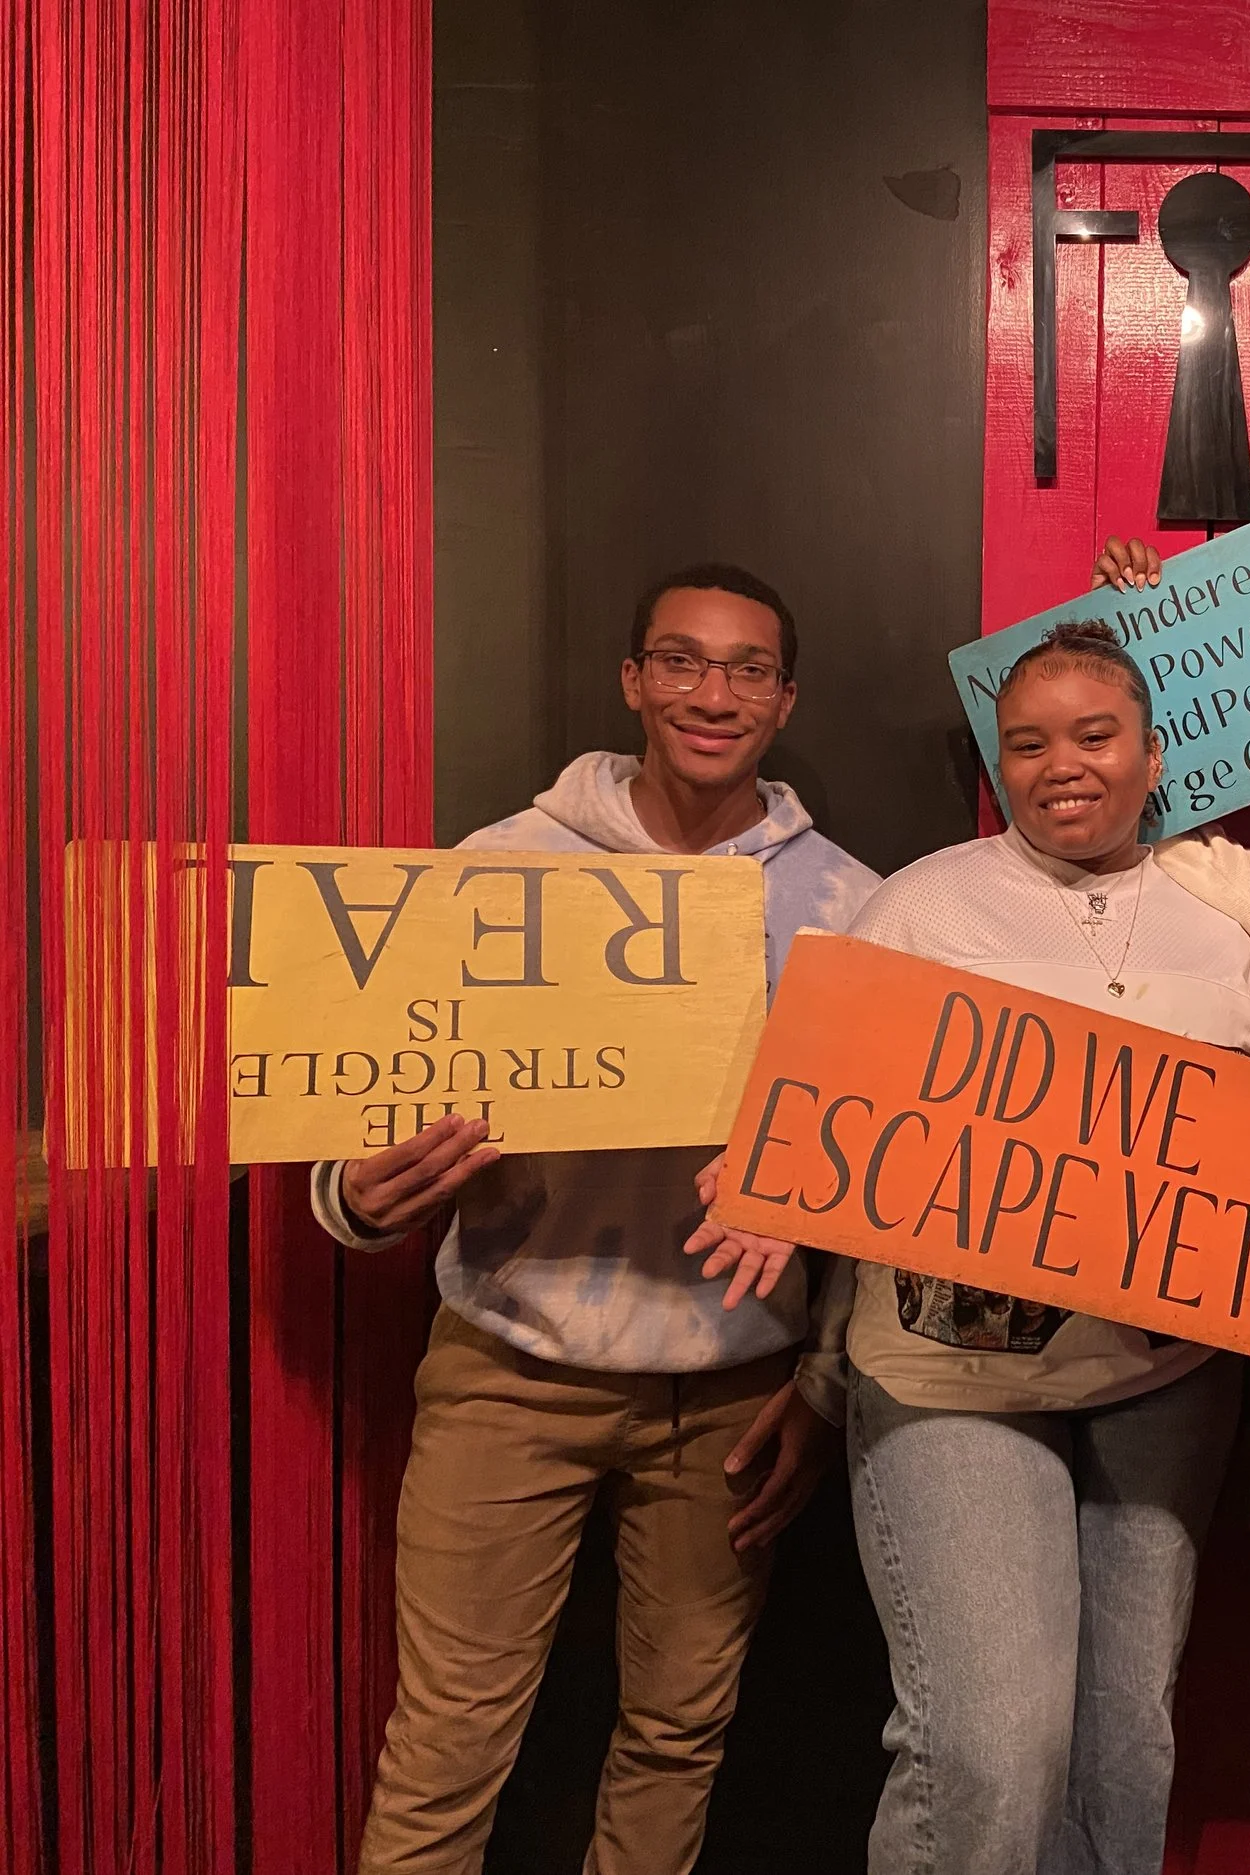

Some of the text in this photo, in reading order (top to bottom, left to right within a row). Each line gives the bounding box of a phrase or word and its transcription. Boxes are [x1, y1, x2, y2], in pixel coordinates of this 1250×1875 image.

[231, 1047, 626, 1098] STRUGGLE
[406, 1000, 464, 1042] IS
[918, 991, 1216, 1176] DID WE
[739, 1077, 1099, 1277] ESCAPE
